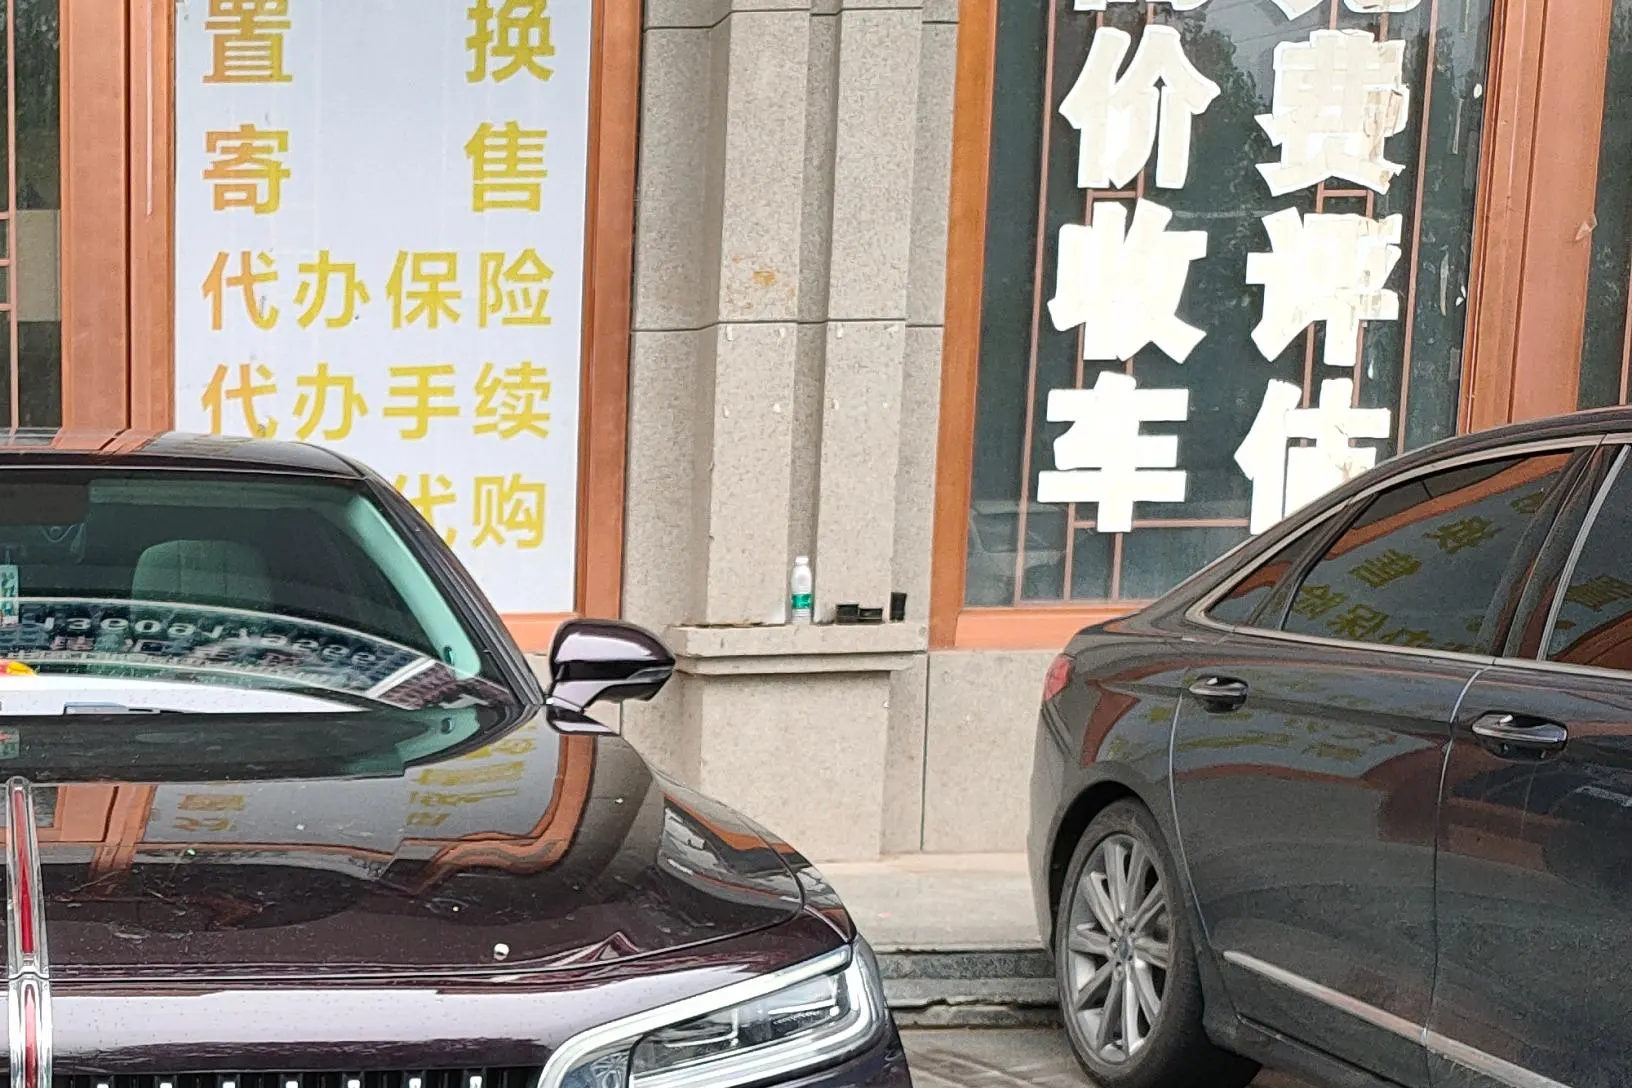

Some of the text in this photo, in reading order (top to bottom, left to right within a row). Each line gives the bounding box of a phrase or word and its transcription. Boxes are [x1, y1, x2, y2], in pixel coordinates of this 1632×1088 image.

[201, 121, 548, 216] 寄售
[201, 248, 555, 331] 代办保险
[1037, 0, 1221, 533] 价收车
[1234, 0, 1416, 535] 费评估
[201, 361, 552, 442] 代办手续
